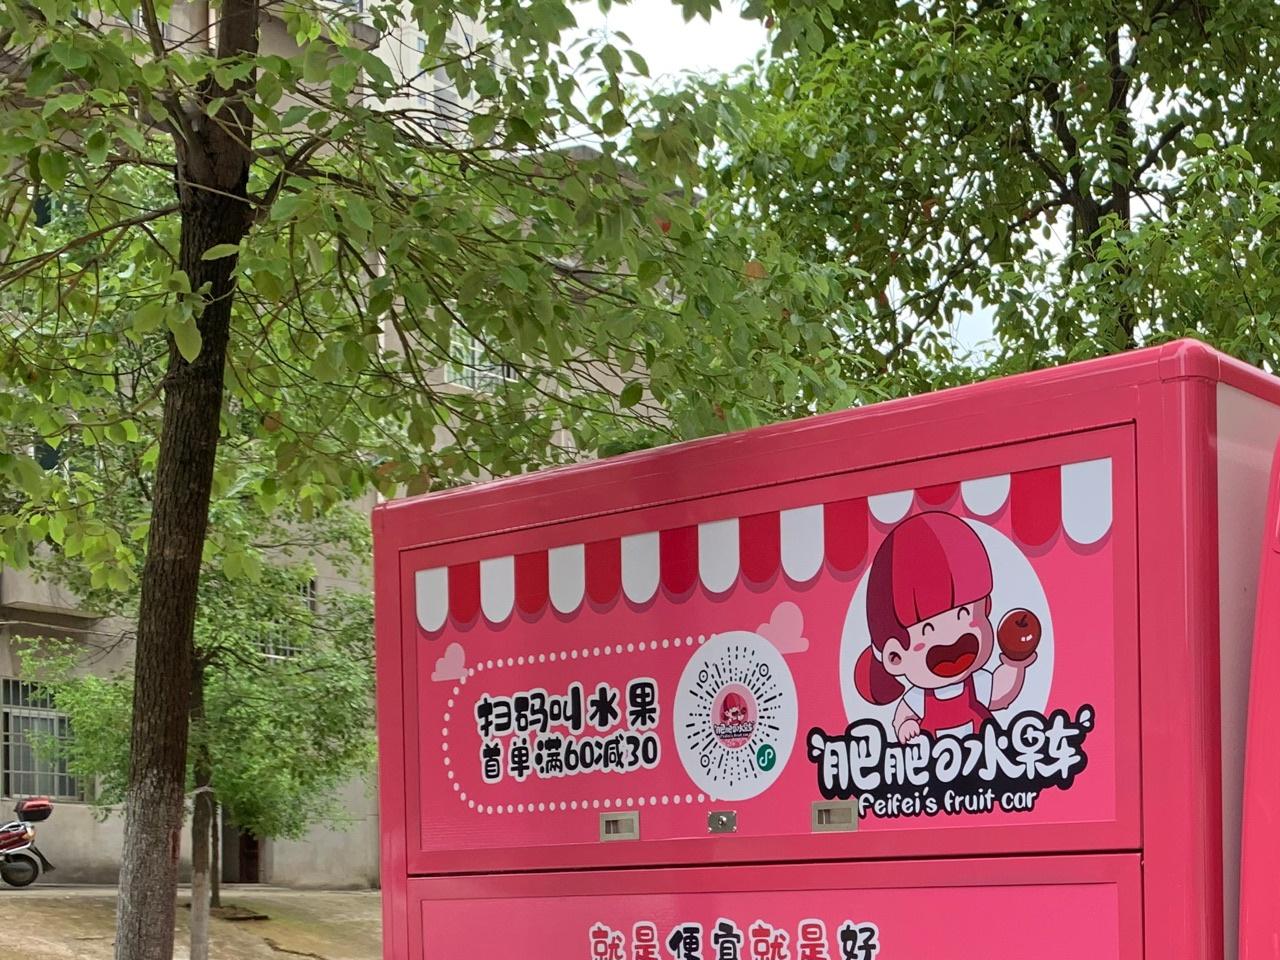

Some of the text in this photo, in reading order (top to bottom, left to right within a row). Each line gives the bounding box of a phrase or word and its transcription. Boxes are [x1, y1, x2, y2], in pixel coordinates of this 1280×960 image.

[476, 682, 657, 737] 扫码叫水果
[482, 734, 658, 779] 首单满60减30
[944, 788, 995, 812] fruit
[1001, 791, 1037, 810] car
